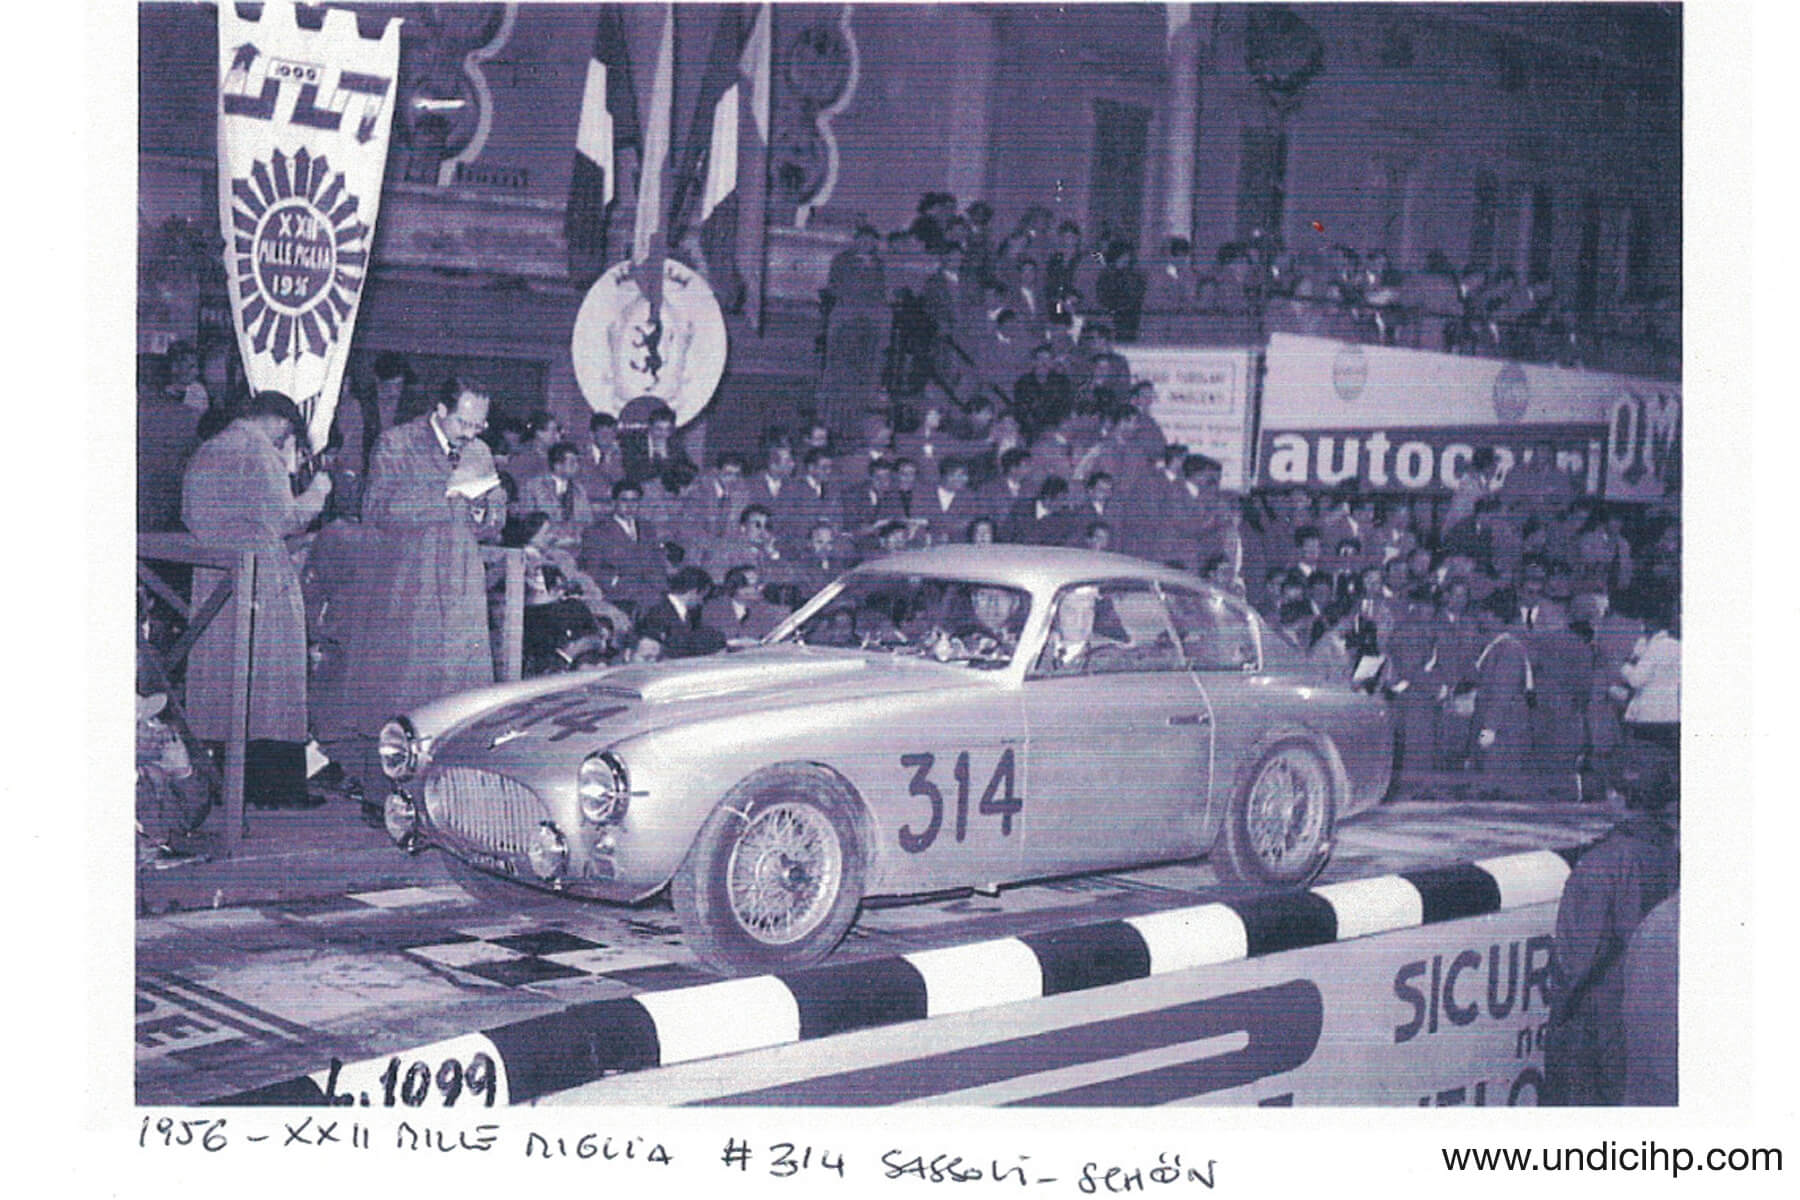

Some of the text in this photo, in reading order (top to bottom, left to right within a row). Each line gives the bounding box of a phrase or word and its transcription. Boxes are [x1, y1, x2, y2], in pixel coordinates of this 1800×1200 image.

[259, 239, 292, 265] MILLE
[898, 747, 1023, 854] 314
[139, 1117, 227, 1151] 1956
[284, 1116, 369, 1148] XXII
[769, 1142, 844, 1176] 314
